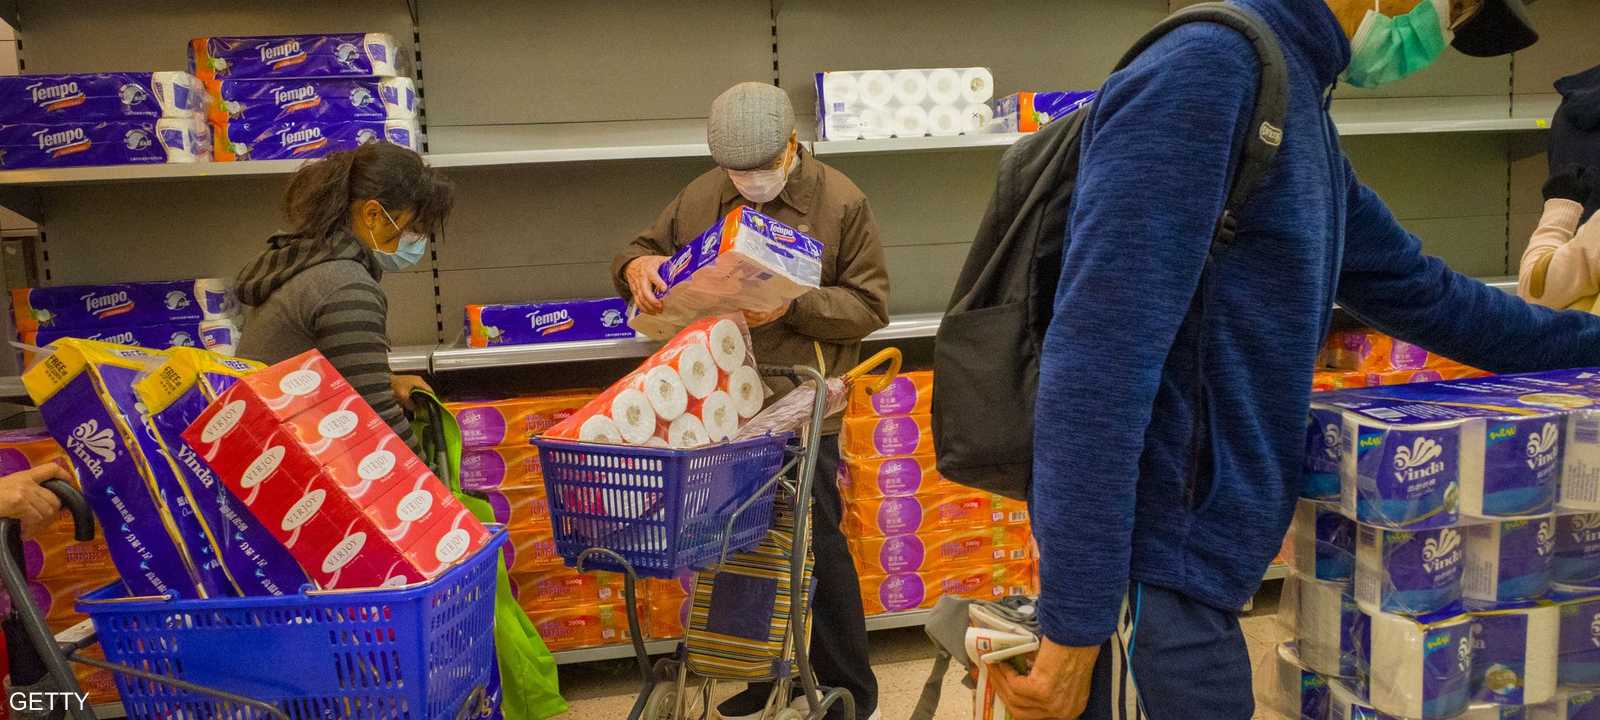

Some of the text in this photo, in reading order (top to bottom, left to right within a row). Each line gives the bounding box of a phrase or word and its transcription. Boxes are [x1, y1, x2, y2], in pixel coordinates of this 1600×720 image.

[257, 41, 300, 62] Tempo
[26, 81, 78, 104] Tempo
[270, 84, 314, 105] Tempo
[35, 127, 84, 150] Tempo
[280, 126, 321, 147] Tempo
[768, 220, 793, 238] Tempo
[80, 290, 128, 311] Tempo
[526, 308, 568, 328] Tempo
[67, 434, 105, 480] Vinda
[177, 443, 214, 489] Vinda
[245, 452, 278, 482] VIRJOY
[1394, 461, 1445, 484] Vinda
[287, 495, 321, 526] VIRJOY
[1572, 530, 1600, 544] Vin
[326, 538, 358, 568] VIRJOY
